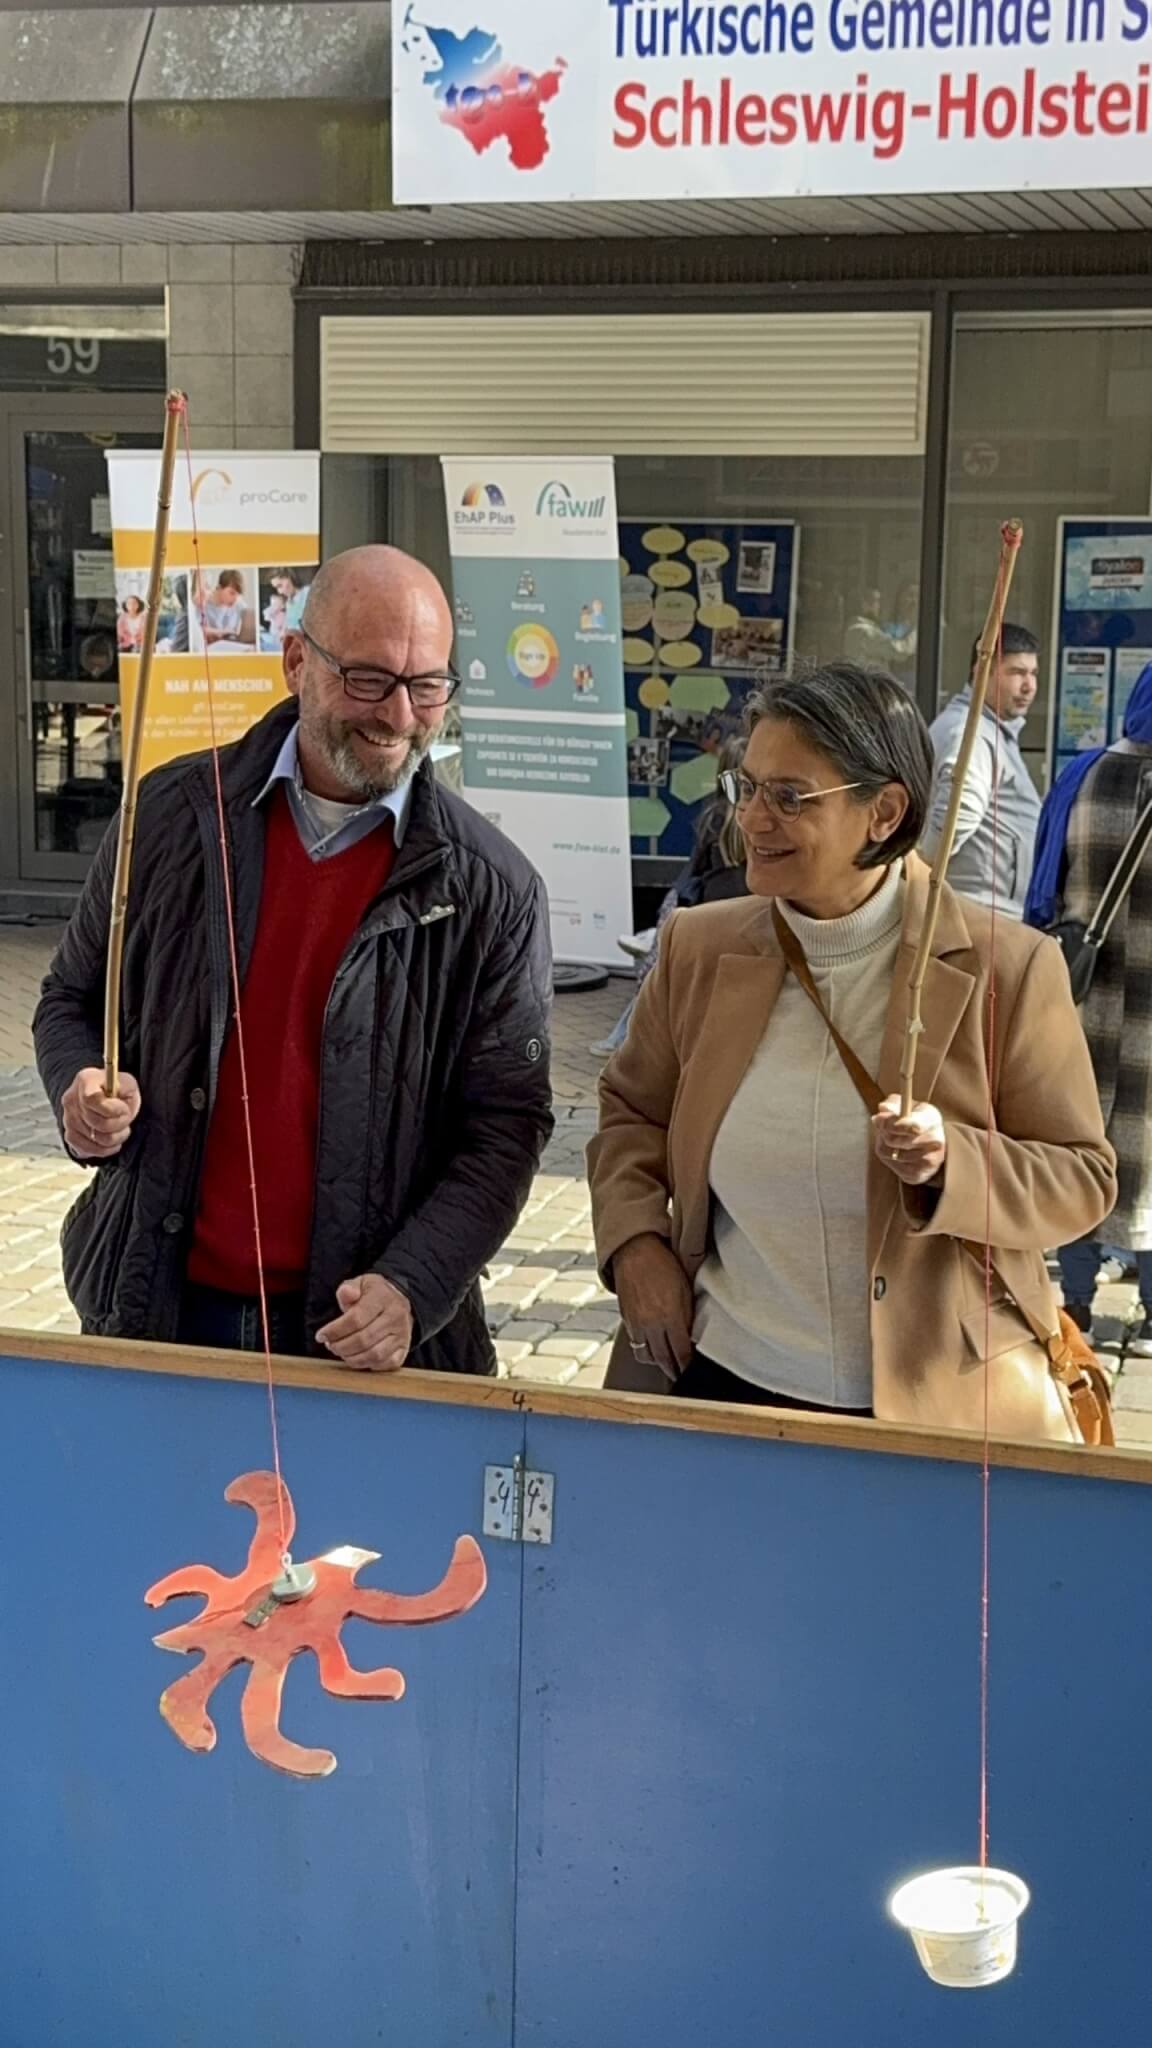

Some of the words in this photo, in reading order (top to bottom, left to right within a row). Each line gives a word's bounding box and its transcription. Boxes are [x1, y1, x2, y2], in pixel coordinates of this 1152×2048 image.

[609, 0, 814, 57] Türkische
[829, 0, 1050, 51] Gemeinde
[1121, 0, 1152, 41] S
[613, 64, 1151, 159] Schleswig-Holstei
[46, 336, 100, 374] 59
[240, 488, 308, 506] proCare
[489, 511, 515, 525] Plus
[165, 679, 189, 693] NAH
[213, 678, 273, 692] MENSCHEN
[498, 1480, 510, 1515] 4
[527, 1479, 540, 1518] 4
